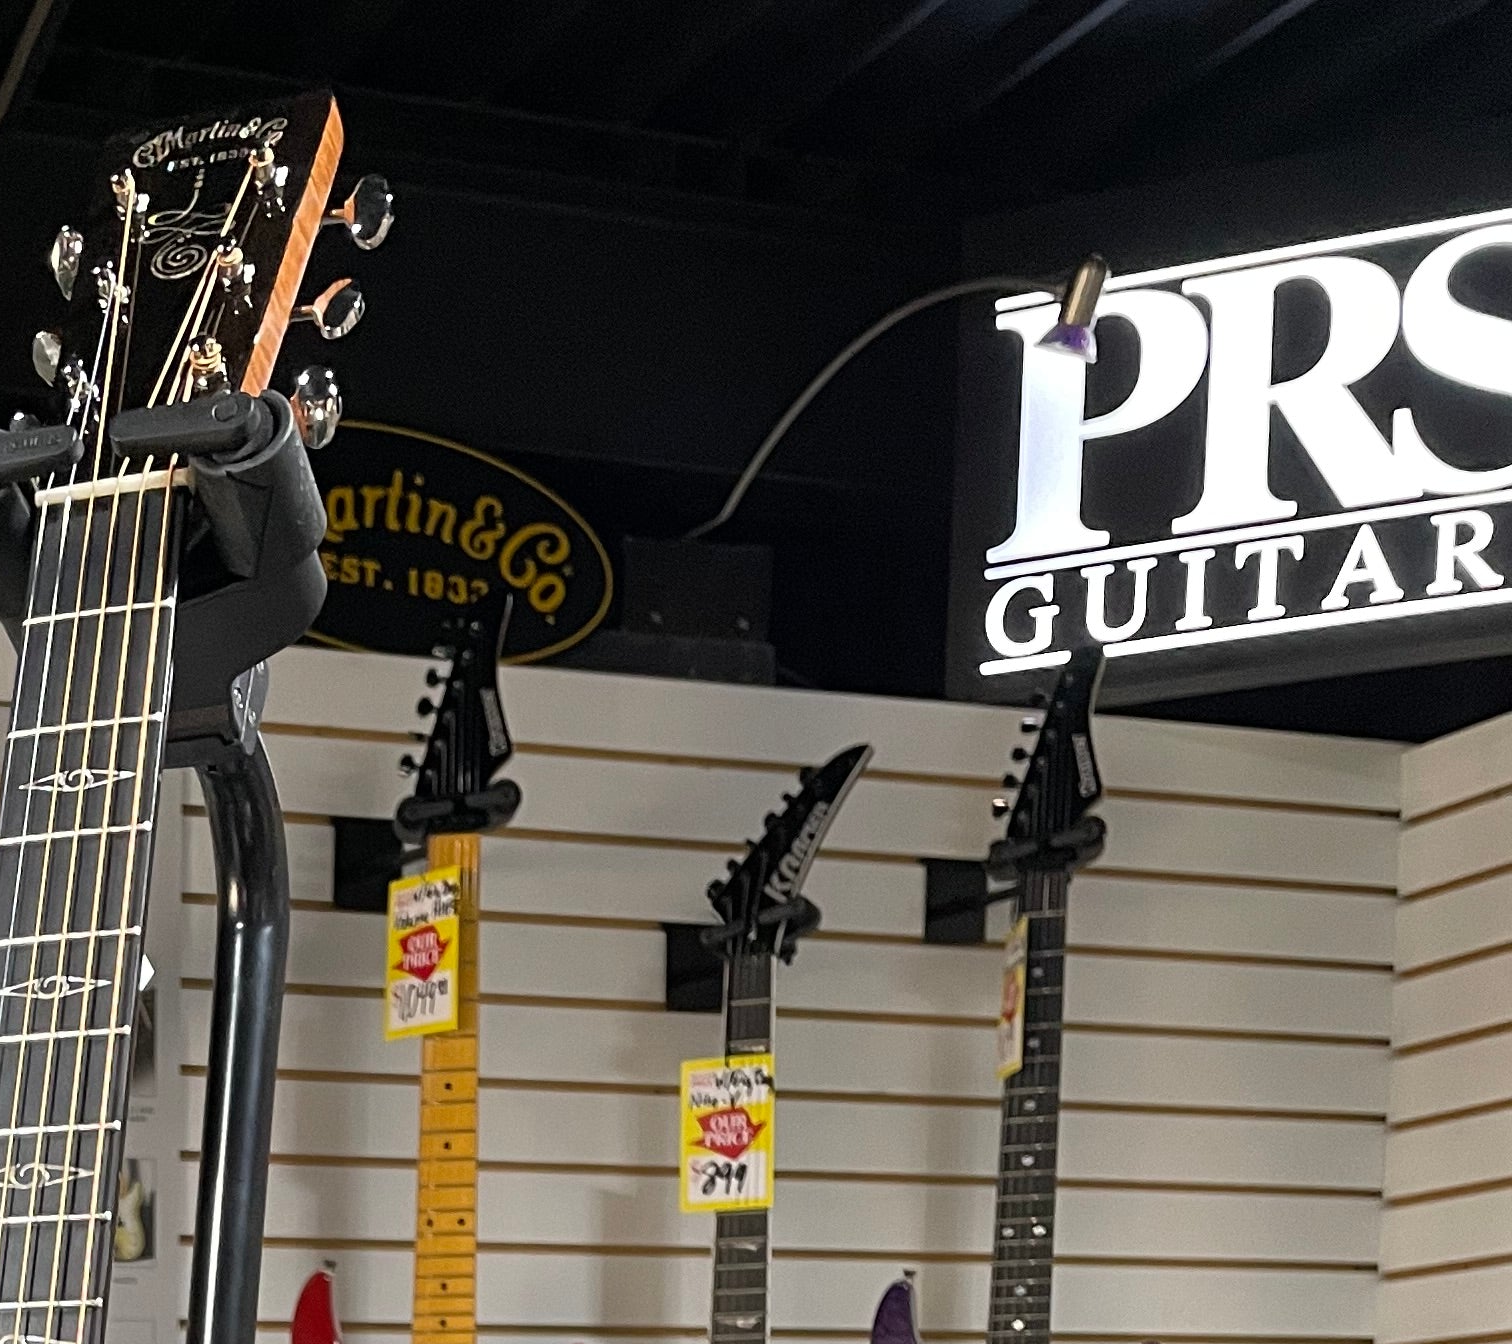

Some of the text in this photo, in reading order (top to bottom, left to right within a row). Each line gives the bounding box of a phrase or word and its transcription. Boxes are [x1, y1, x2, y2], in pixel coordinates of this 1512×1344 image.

[986, 223, 1512, 564] PRS
[322, 552, 394, 591] EST.
[709, 1113, 748, 1131] OUR
